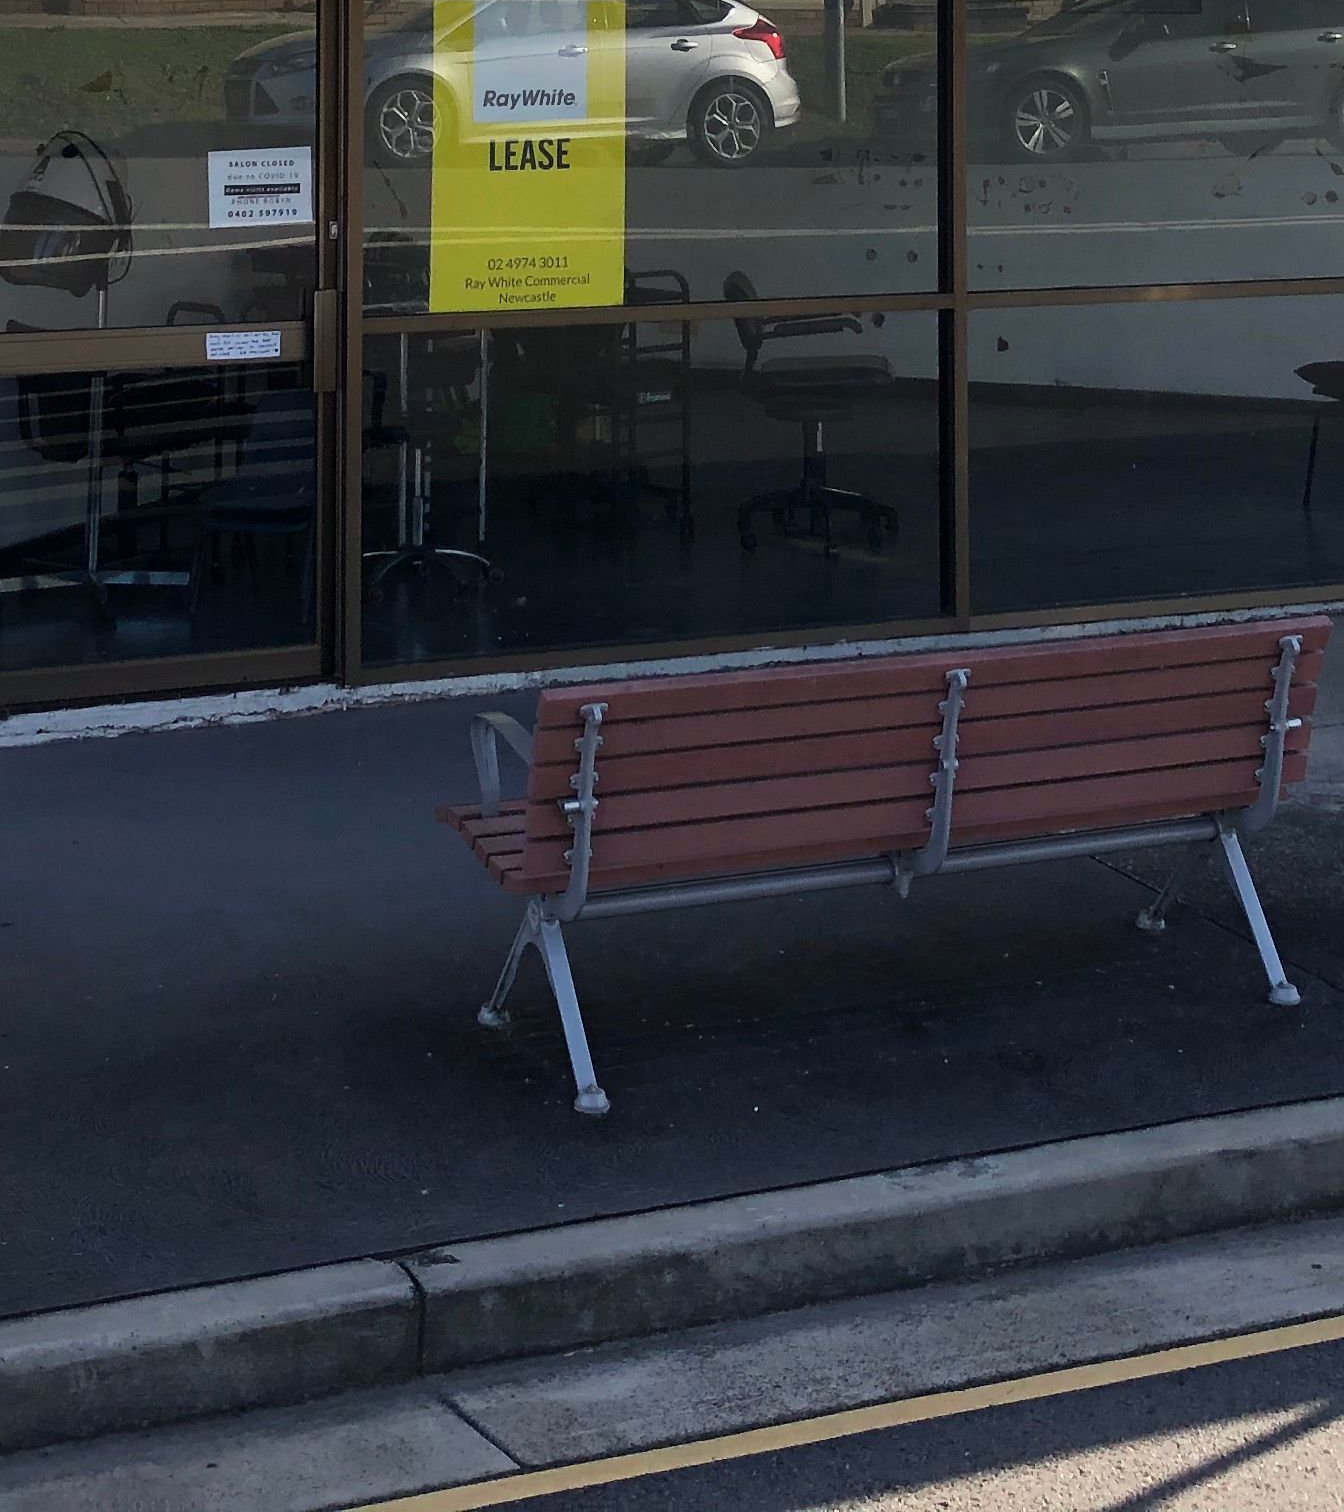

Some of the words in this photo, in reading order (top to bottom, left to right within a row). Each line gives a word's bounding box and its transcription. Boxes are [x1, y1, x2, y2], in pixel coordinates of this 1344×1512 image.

[488, 138, 571, 171] LEASE
[261, 159, 295, 167] CLOSED
[228, 210, 254, 218] 0402
[487, 259, 504, 271] 02
[506, 257, 537, 270] 4974
[539, 255, 568, 268] 3011
[465, 277, 486, 291] Ray
[488, 275, 523, 288] White
[524, 273, 591, 287] Commercial
[499, 291, 557, 305] Newcastle
